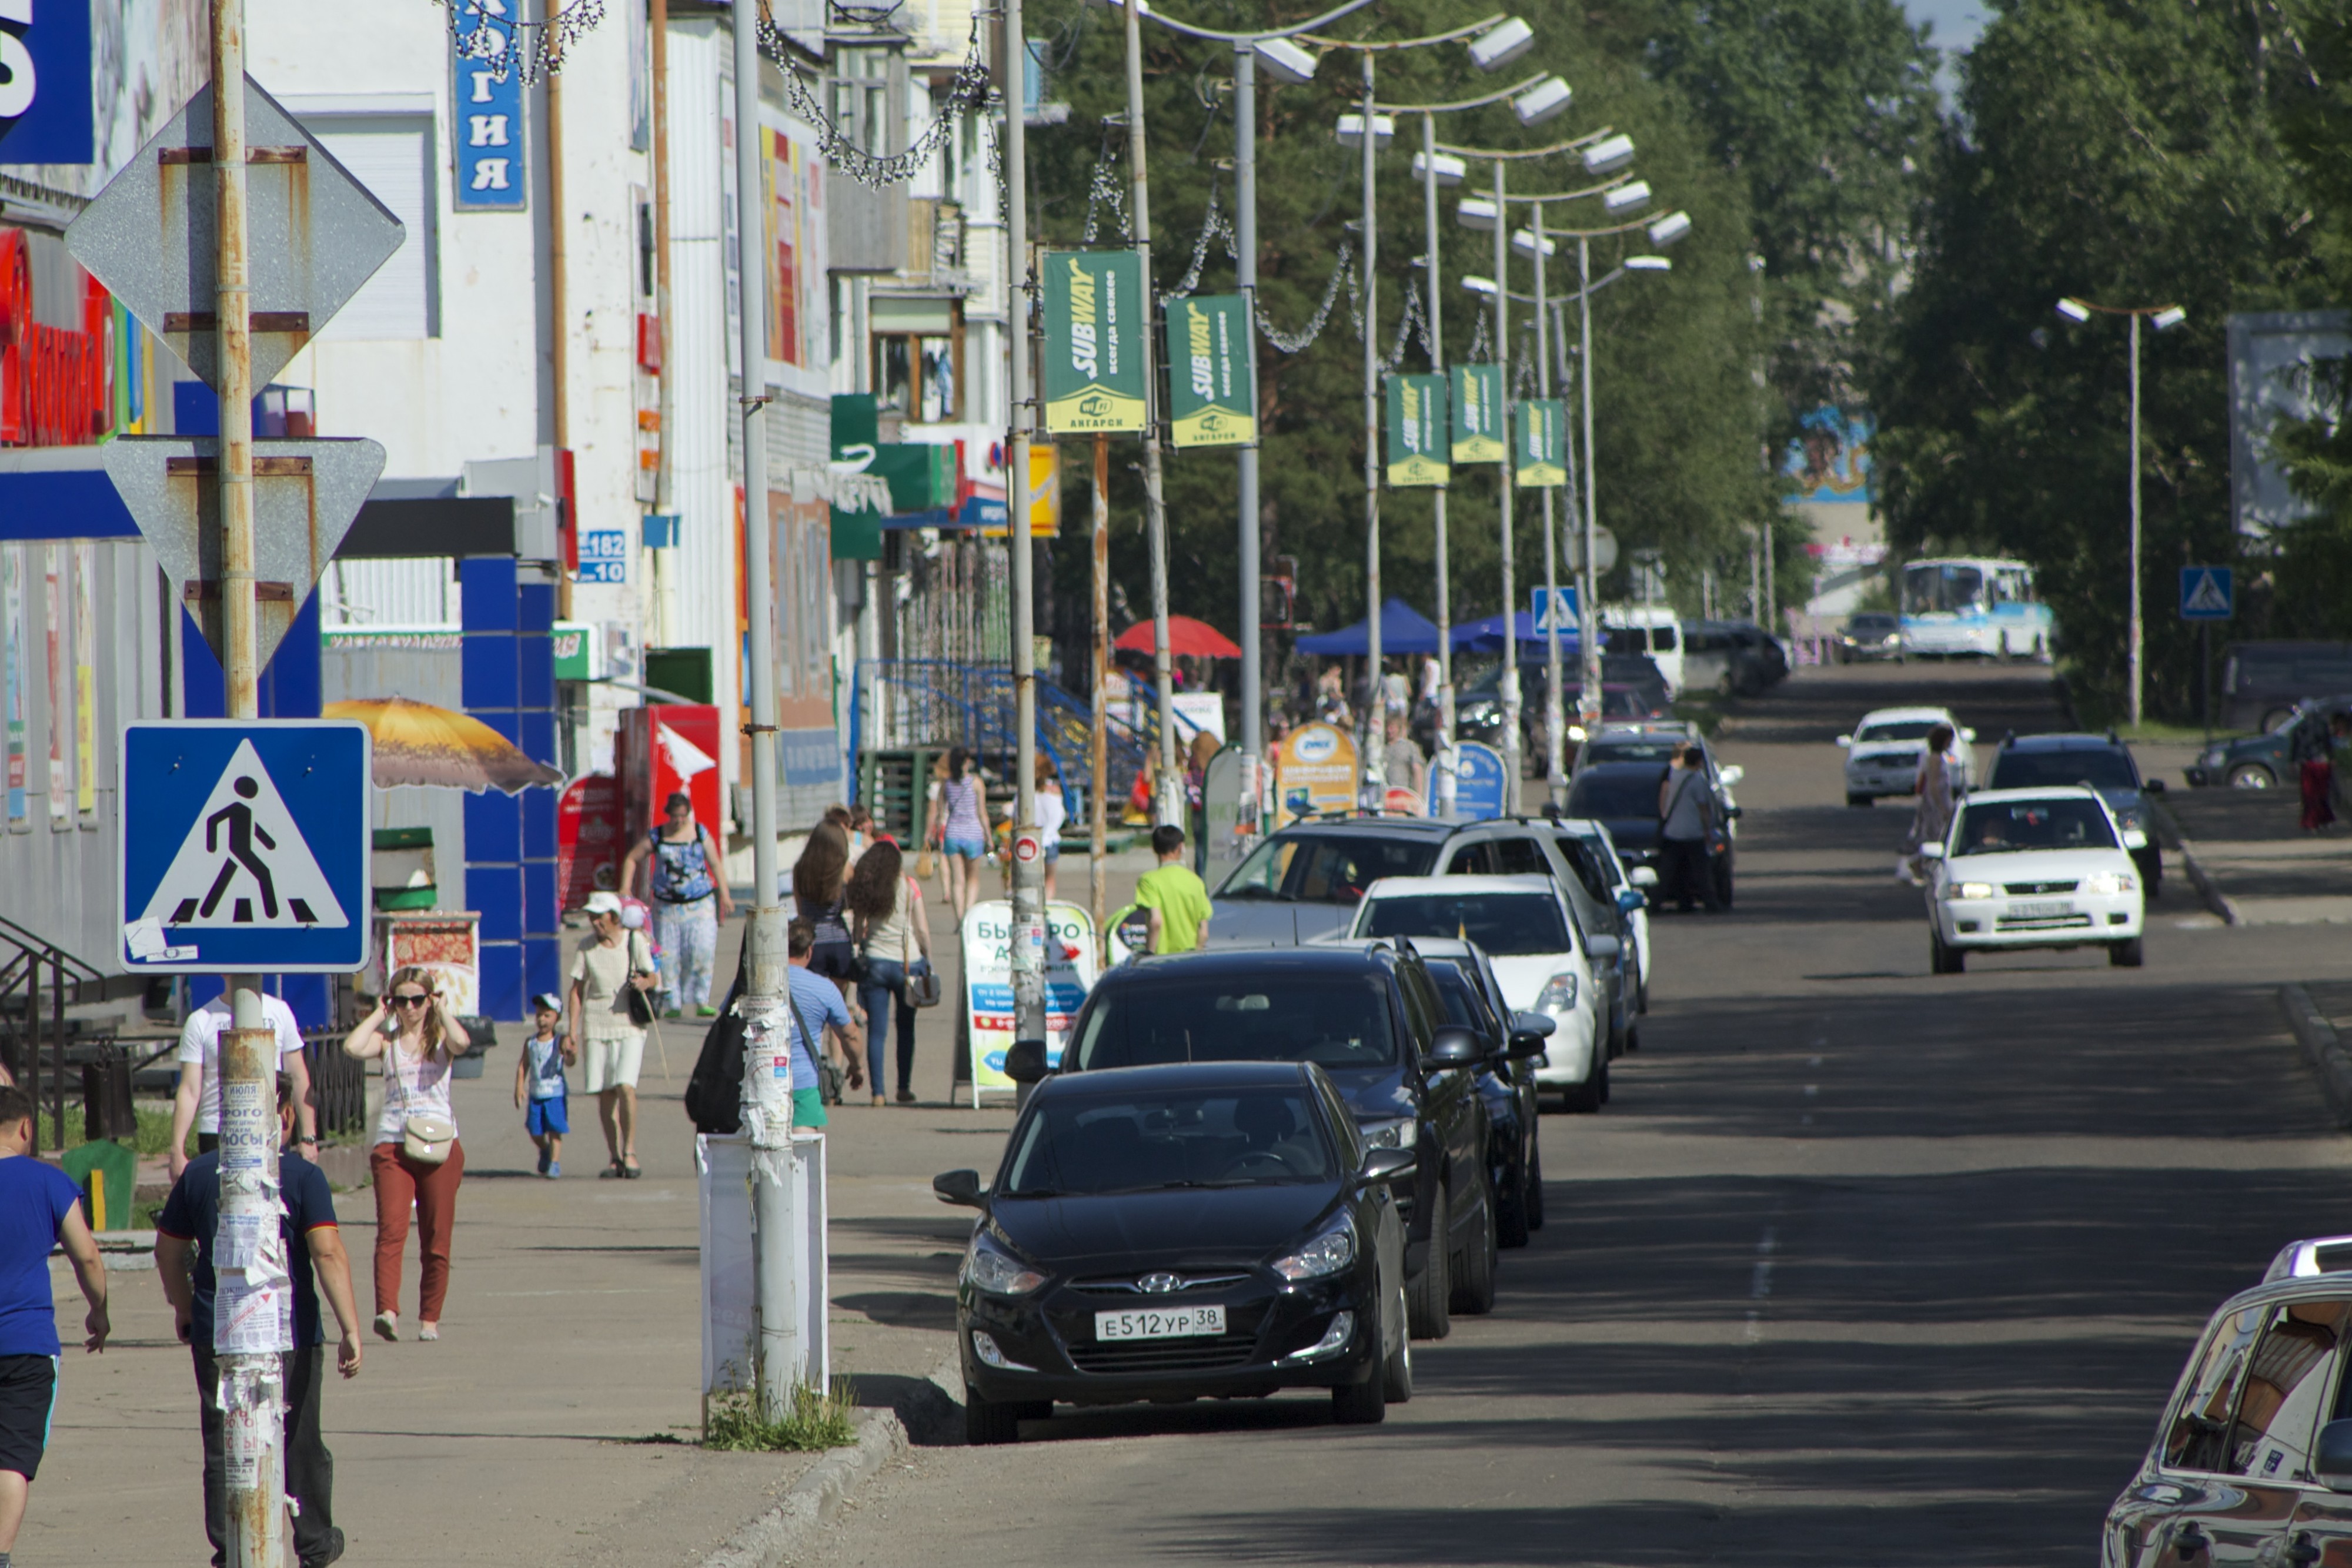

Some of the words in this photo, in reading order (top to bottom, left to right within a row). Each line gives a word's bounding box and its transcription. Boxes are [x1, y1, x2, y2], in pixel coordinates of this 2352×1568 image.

[1106, 270, 1116, 324] свежее
[1068, 258, 1098, 380] SUBWAY
[1108, 326, 1118, 375] всегда
[1187, 302, 1215, 402] SUBWAY
[1070, 418, 1123, 428] АНГАРСК
[590, 534, 625, 557] 182
[595, 563, 624, 581] 10
[978, 922, 1080, 940] БЫРО
[229, 1085, 257, 1095] ИЮЛЯ
[1105, 1314, 1190, 1337] Е512УР
[1195, 1309, 1217, 1325] 38
